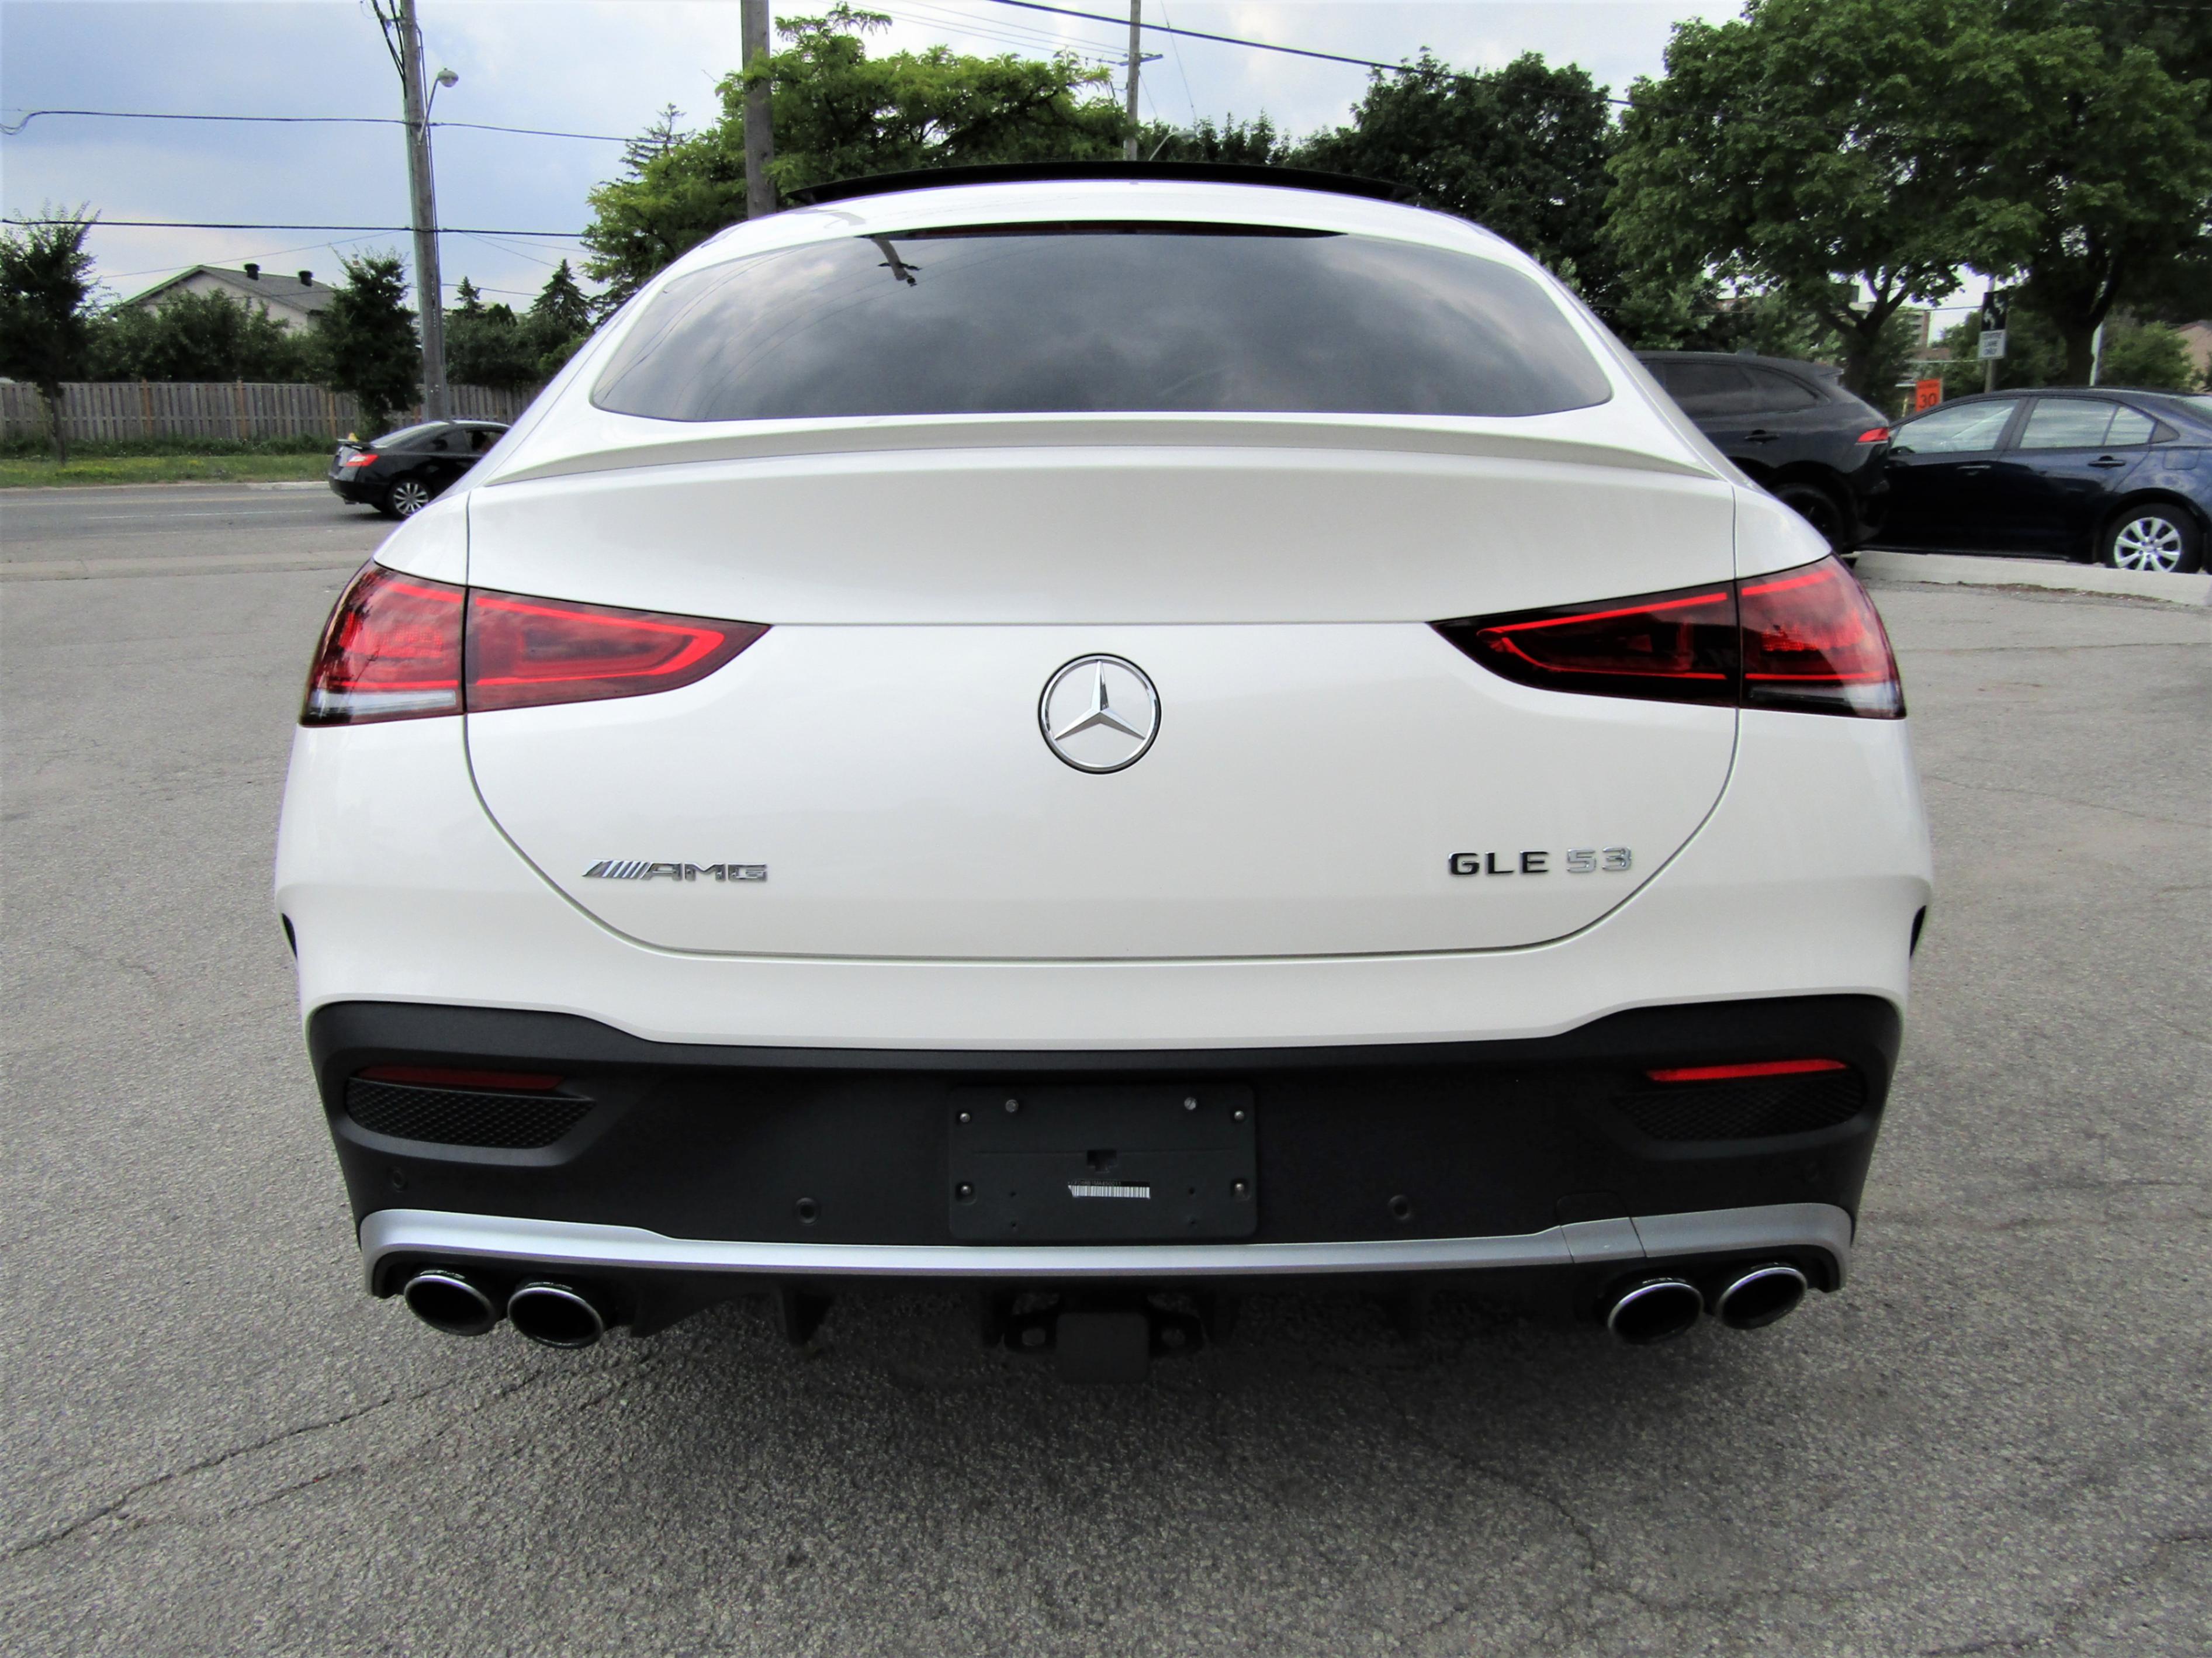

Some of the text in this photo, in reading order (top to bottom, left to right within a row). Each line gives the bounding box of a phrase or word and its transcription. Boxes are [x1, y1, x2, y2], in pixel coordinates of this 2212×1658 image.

[1919, 392, 1937, 409] 30
[642, 861, 767, 881] AMG
[1448, 847, 1632, 875] GLE 53
